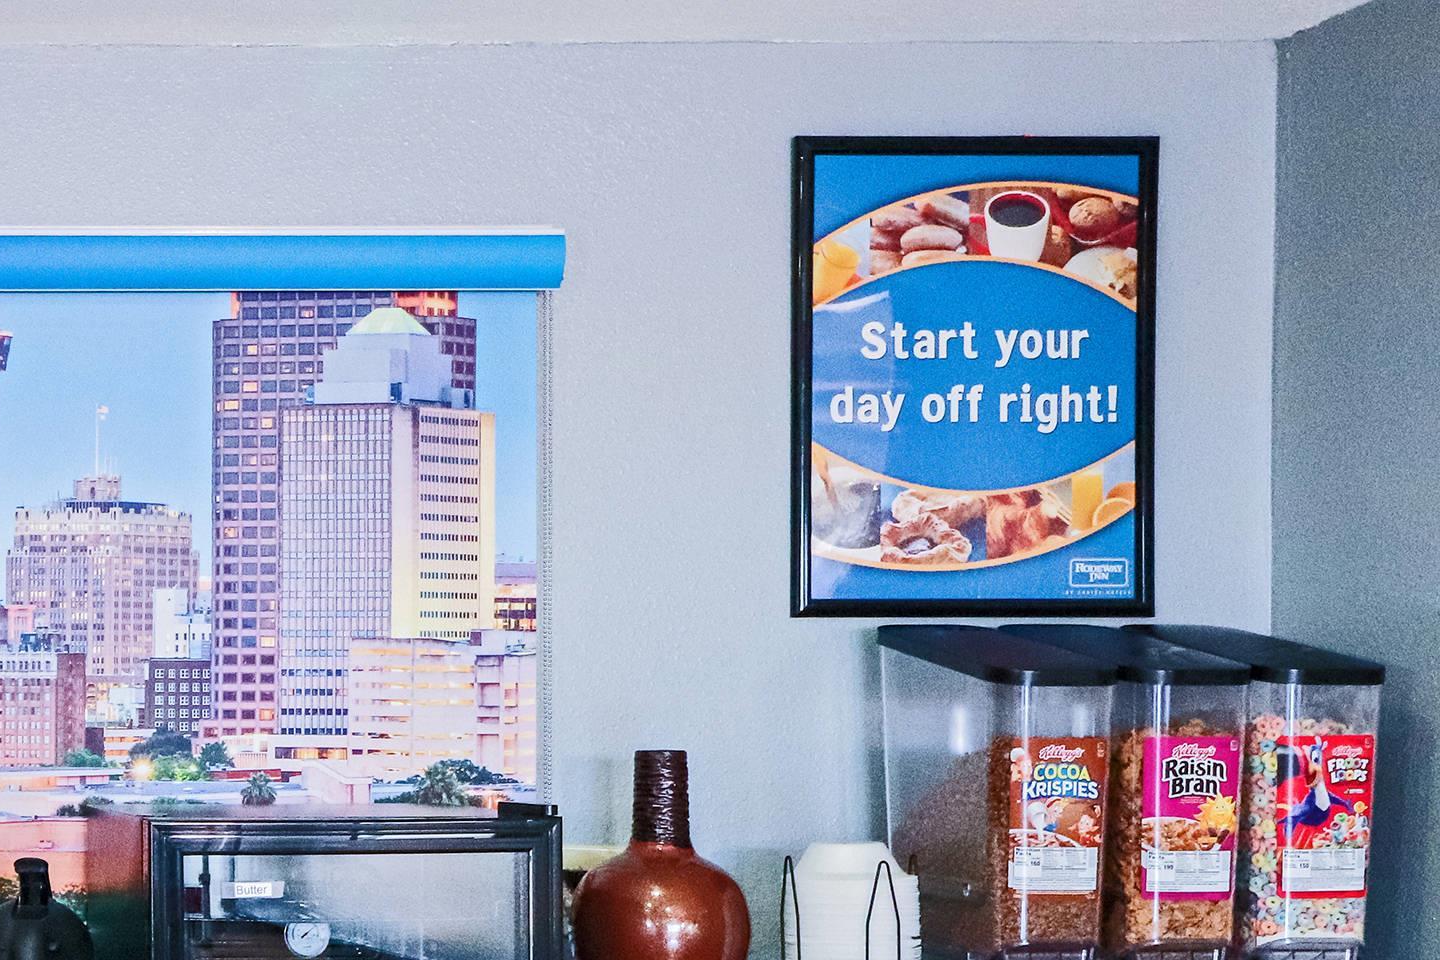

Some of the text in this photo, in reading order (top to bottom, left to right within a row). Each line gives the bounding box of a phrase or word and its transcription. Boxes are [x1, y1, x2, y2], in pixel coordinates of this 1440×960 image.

[861, 321, 1090, 368] Start your
[830, 383, 1118, 434] day off right!
[1039, 744, 1085, 762] Kellogg's
[1172, 743, 1217, 760] Kellogg's
[1033, 764, 1091, 781] COCOA
[1164, 759, 1225, 779] Raisin
[1327, 757, 1369, 773] FROOT
[1330, 769, 1369, 784] LOOPS
[1022, 780, 1100, 799] KRISPIES
[1170, 777, 1219, 797] Bran
[236, 885, 267, 895] Butter
